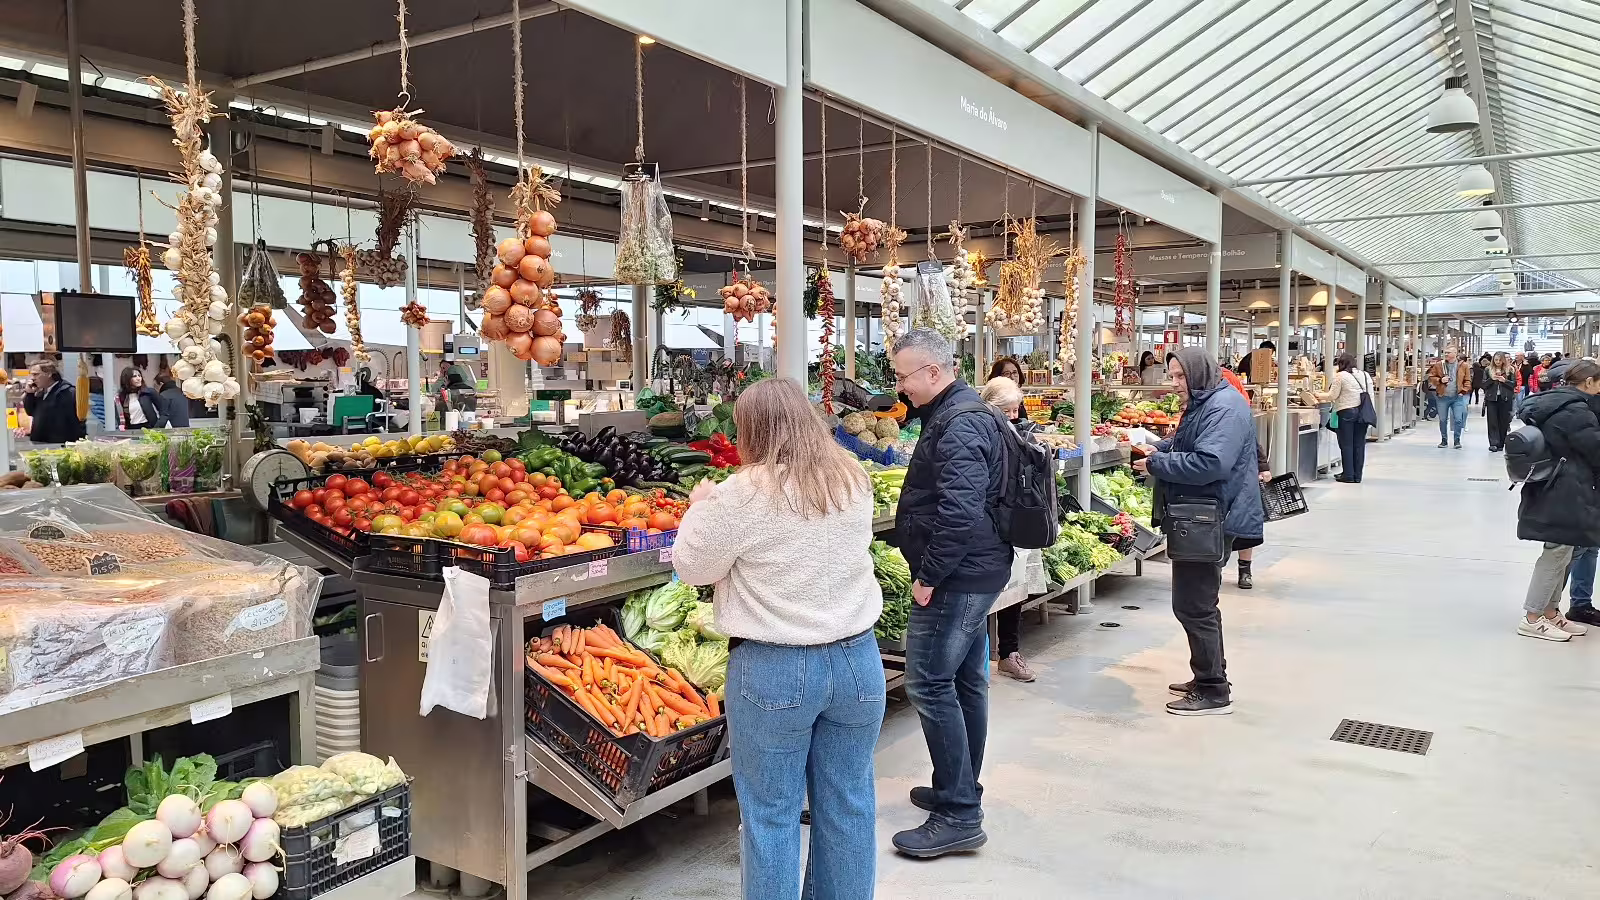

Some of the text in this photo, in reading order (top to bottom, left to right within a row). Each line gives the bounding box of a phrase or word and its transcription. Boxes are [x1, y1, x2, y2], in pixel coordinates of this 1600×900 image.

[960, 95, 1008, 131] Maria do Álvaro
[1178, 252, 1208, 260] Tempero
[1222, 249, 1246, 257] Bolhão
